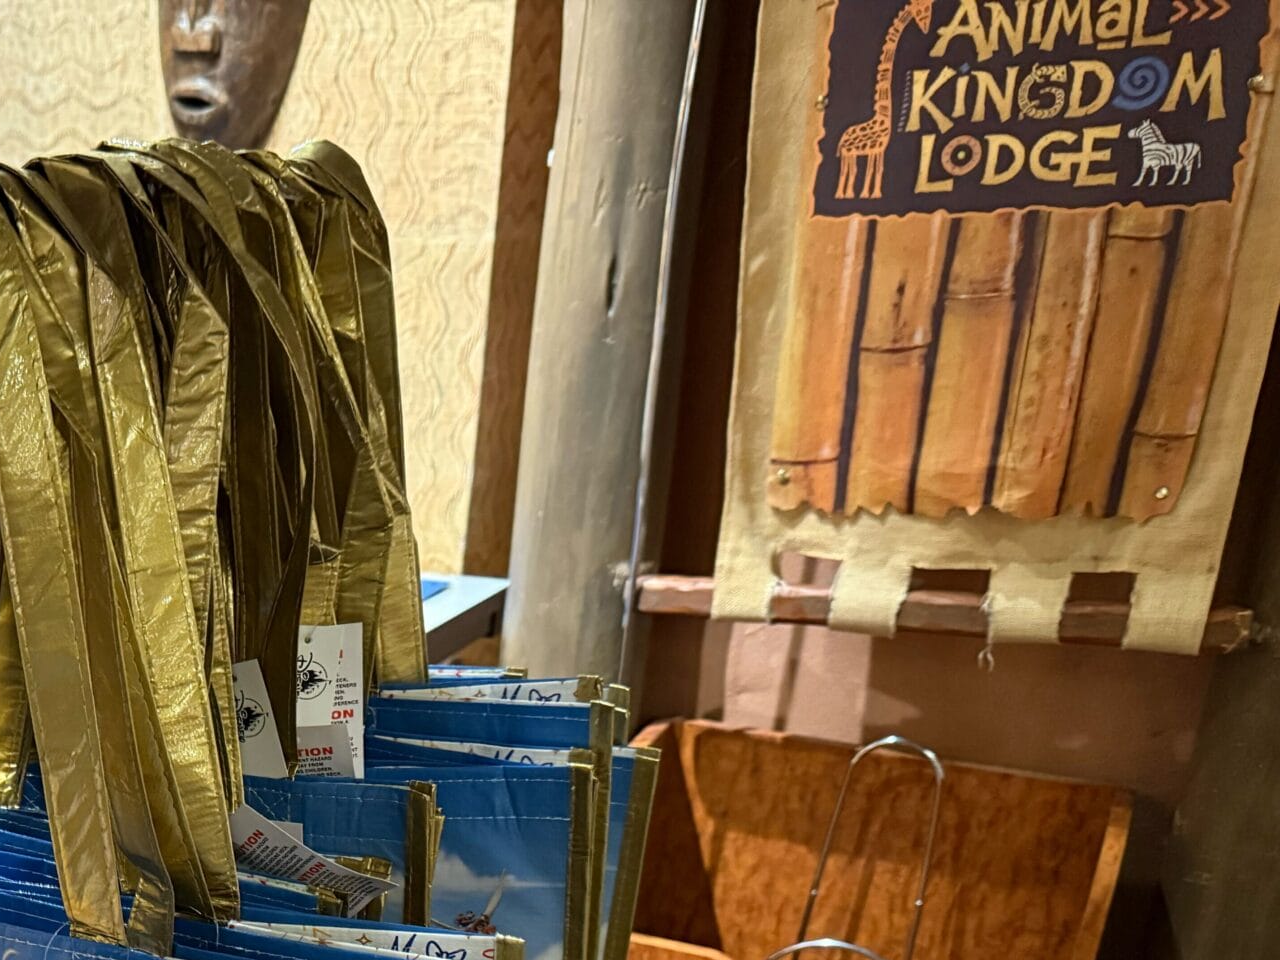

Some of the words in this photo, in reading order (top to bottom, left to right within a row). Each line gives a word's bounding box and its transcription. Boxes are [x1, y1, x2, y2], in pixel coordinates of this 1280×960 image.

[914, 123, 1121, 193] LODGE
[297, 746, 333, 757] TION
[240, 829, 264, 852] TION
